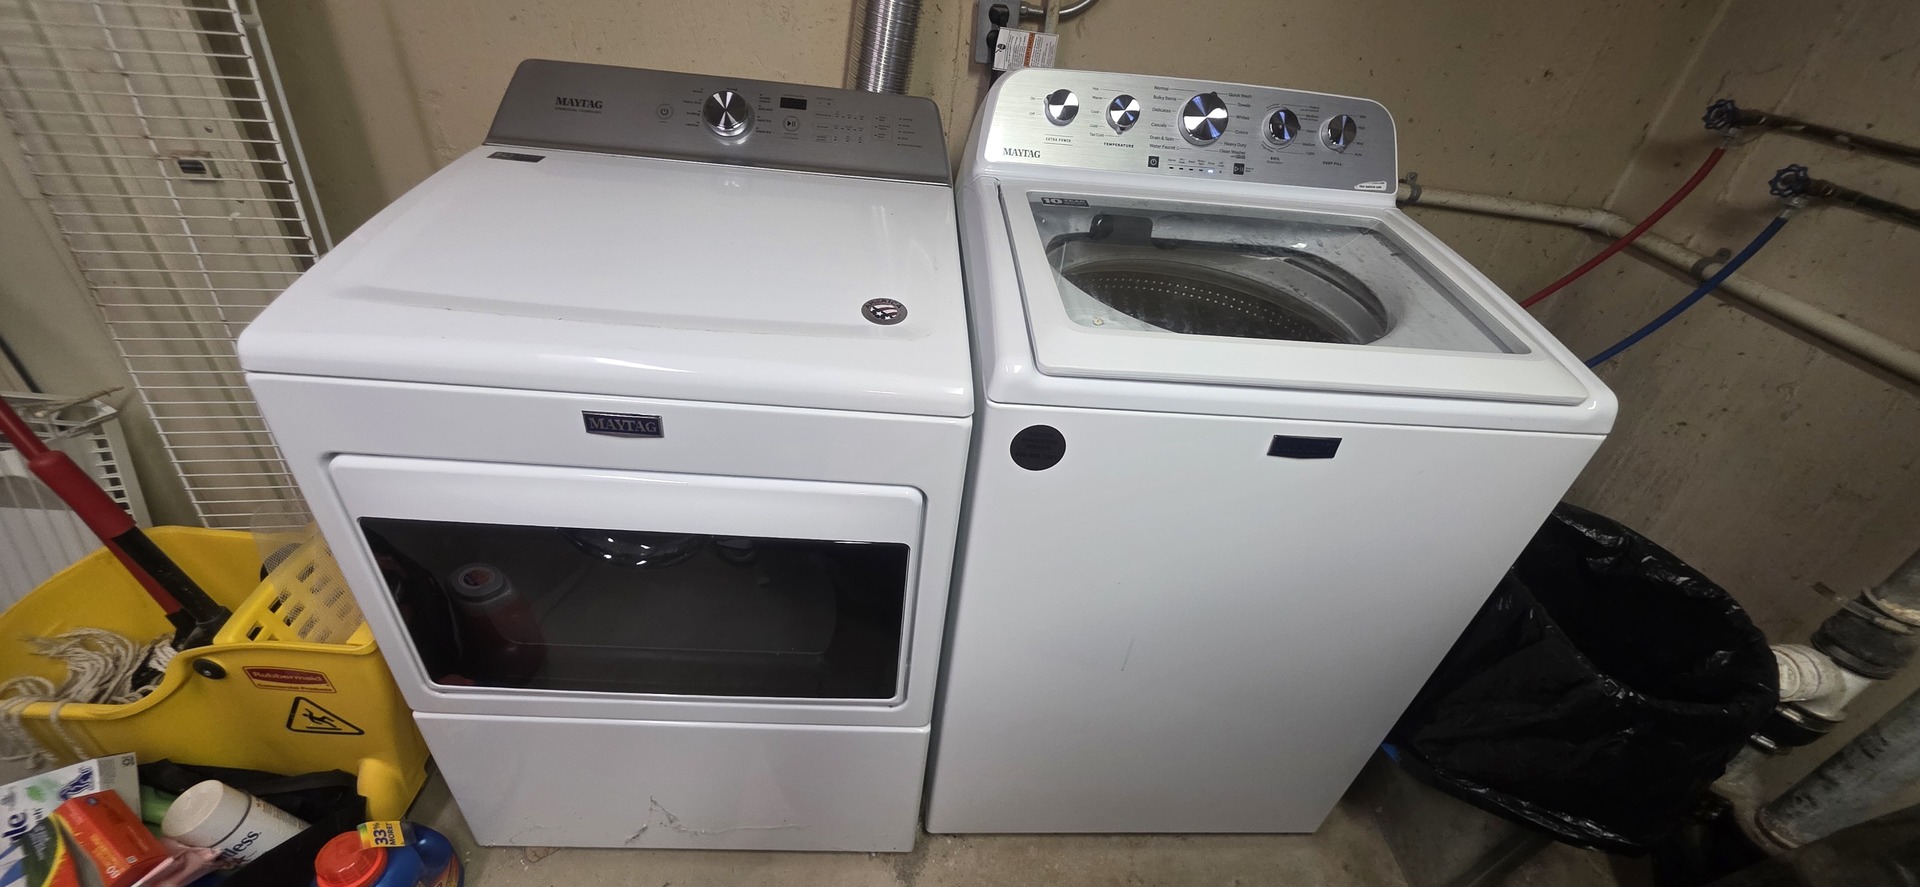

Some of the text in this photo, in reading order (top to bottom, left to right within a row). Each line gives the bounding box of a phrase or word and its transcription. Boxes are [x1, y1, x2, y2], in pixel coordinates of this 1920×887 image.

[555, 97, 602, 109] MAYTAG
[1003, 148, 1040, 158] MAYTAG
[589, 418, 656, 432] MAYTAG
[253, 671, 322, 682] Rubbermaid
